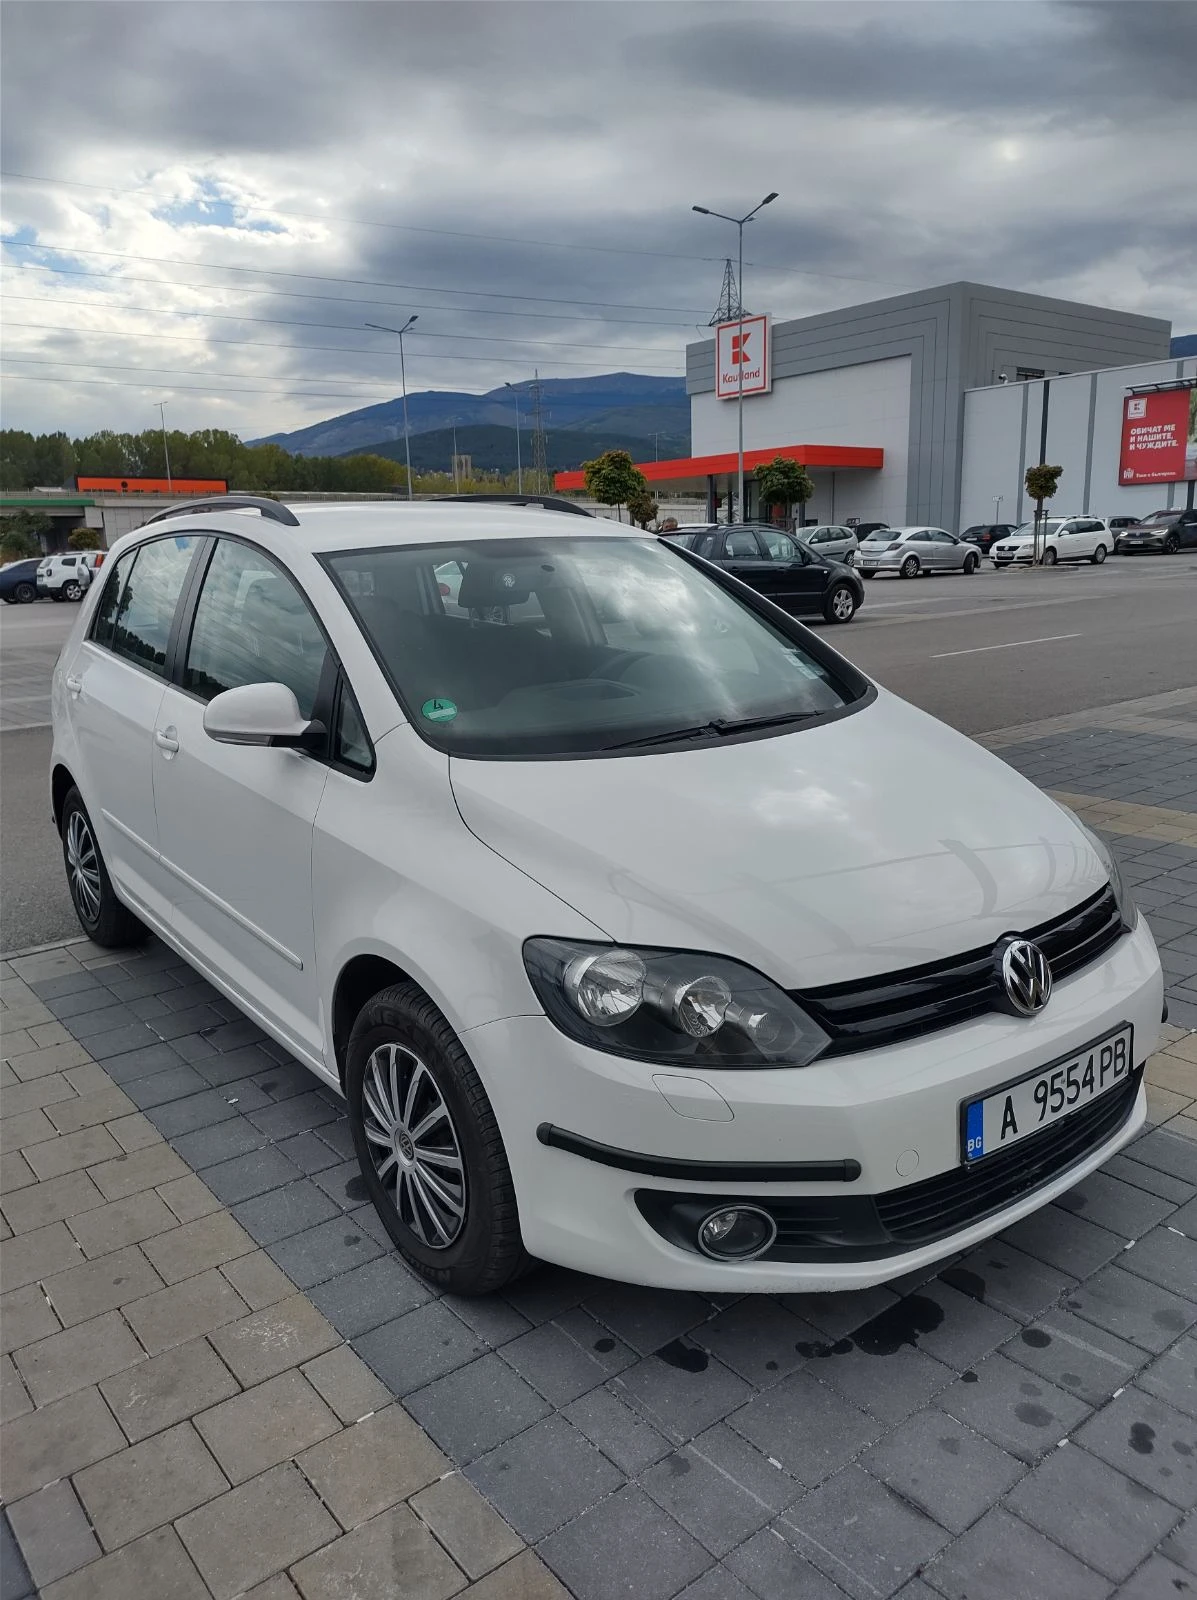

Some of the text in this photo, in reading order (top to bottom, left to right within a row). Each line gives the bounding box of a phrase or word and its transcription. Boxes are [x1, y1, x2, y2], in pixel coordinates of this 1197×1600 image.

[1131, 424, 1176, 435] ОБИЧАТ МЕ
[434, 699, 443, 709] 4
[1000, 1037, 1126, 1140] A 9554 PB
[967, 1136, 982, 1152] BG
